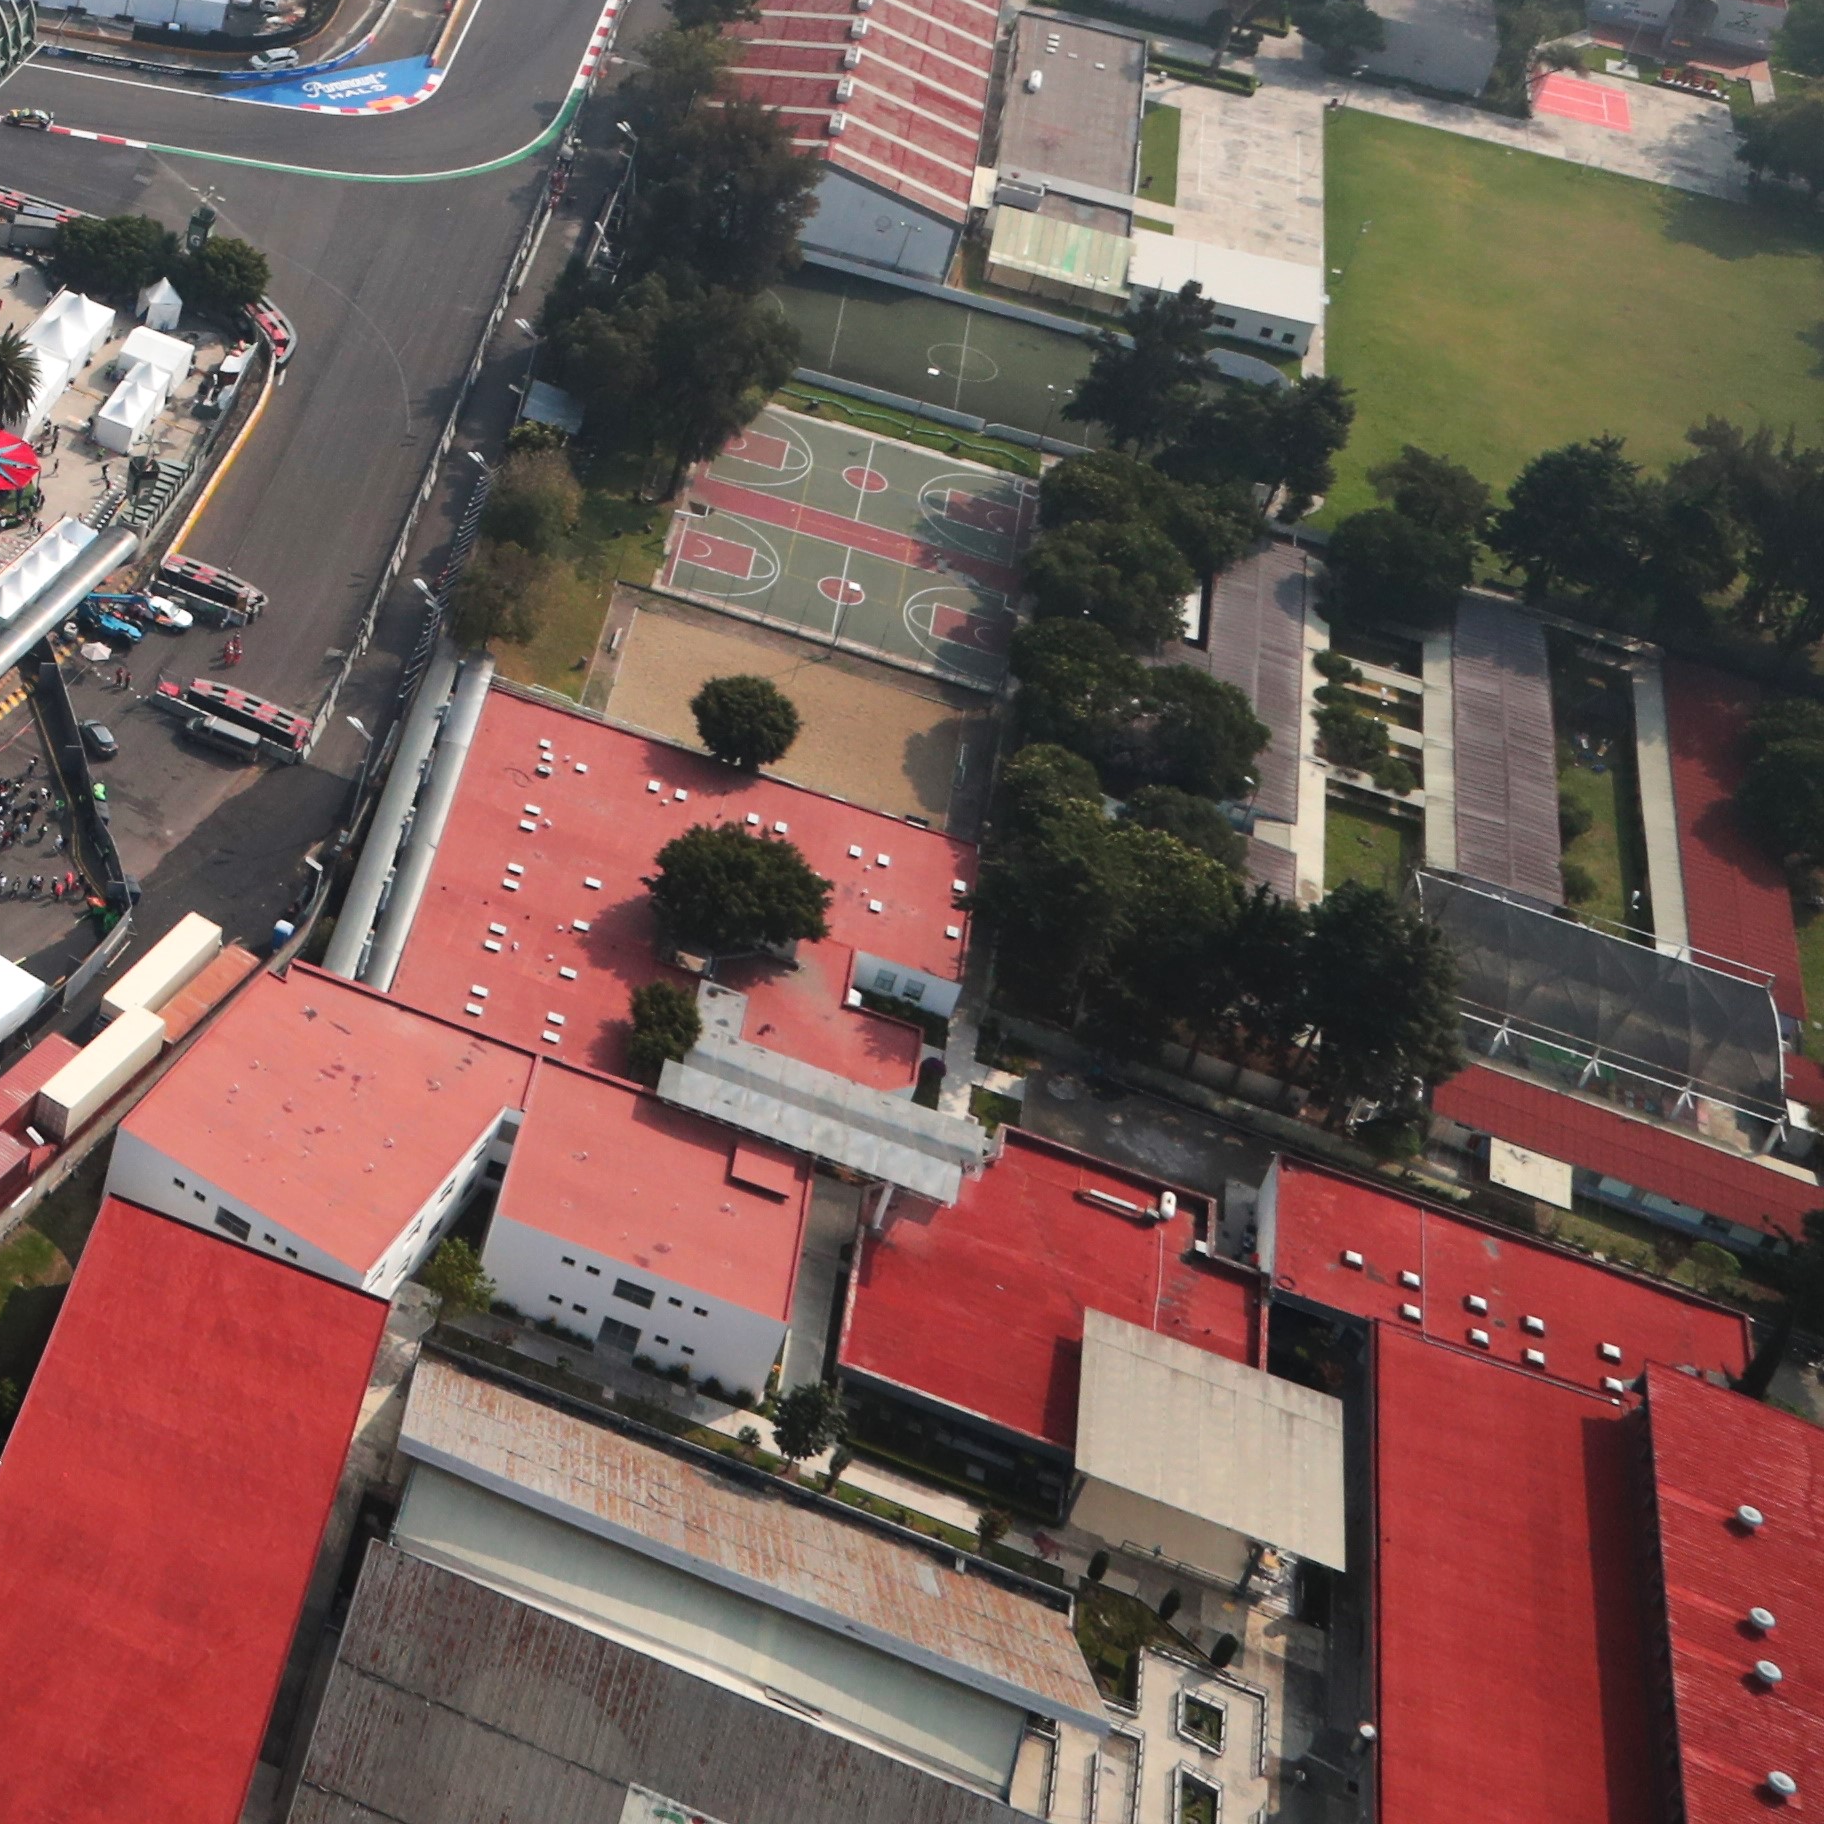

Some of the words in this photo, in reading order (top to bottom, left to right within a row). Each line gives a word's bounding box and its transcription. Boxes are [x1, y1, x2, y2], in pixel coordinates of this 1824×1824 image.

[302, 71, 388, 98] Paramount+
[190, 234, 201, 247] G
[138, 487, 150, 499] F
